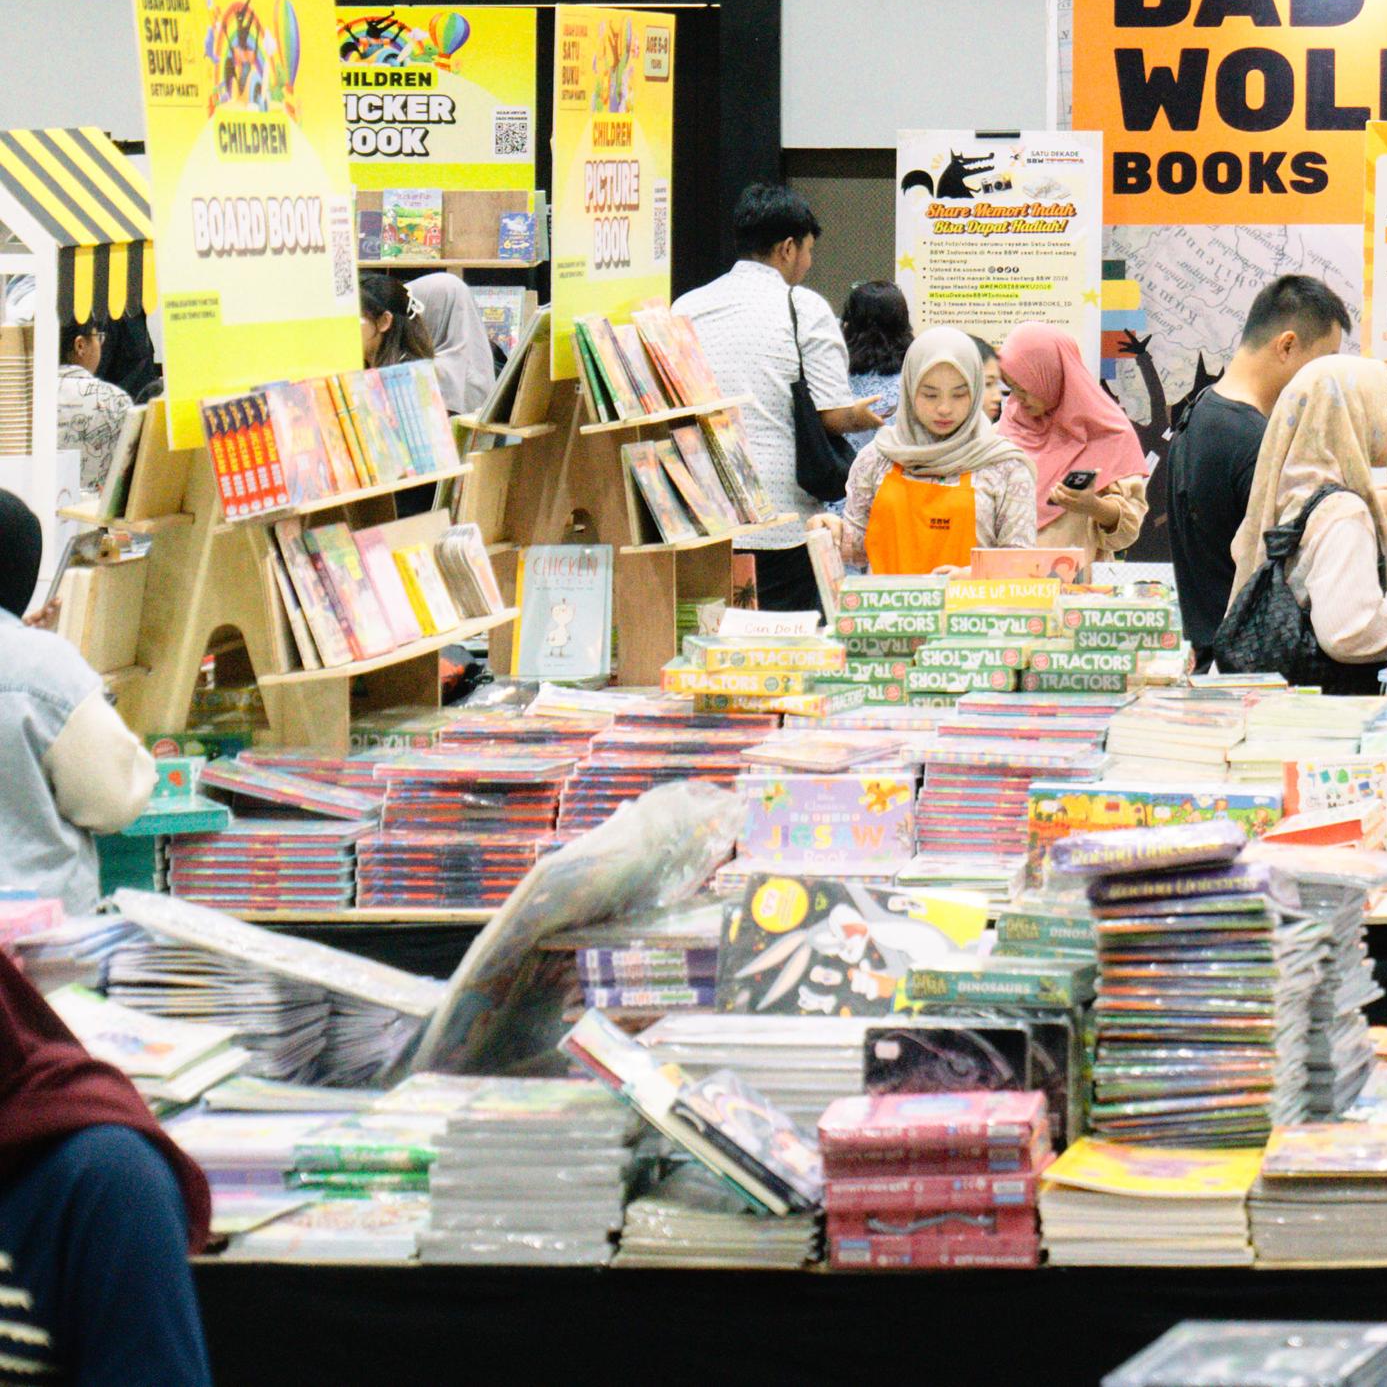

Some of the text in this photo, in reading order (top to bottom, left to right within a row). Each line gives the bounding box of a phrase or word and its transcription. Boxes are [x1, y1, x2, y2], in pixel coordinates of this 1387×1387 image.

[144, 18, 179, 44] SATU
[563, 42, 579, 60] SATU
[148, 50, 182, 75] BUKU
[342, 72, 432, 87] HILDREN
[562, 67, 579, 85] BUKU
[219, 123, 288, 154] CHILDREN
[593, 121, 632, 147] CHILDREN
[1113, 151, 1329, 195] BOOKS
[585, 160, 640, 212] PICTURE
[926, 202, 1077, 218] Share Memori Indah
[192, 196, 325, 258] BOARD BOOK
[933, 220, 964, 234] Bisa
[967, 221, 1010, 236] Dapat
[594, 216, 630, 269] BOOK
[861, 592, 941, 607] TRACTORS
[949, 585, 1005, 599] WAKE UP
[856, 617, 935, 632] TRACTORS
[950, 618, 1027, 632] TRACTORS
[1083, 611, 1165, 627] TRACTORS
[1079, 632, 1160, 647] TRACTORS
[750, 651, 825, 666] TRACTORS
[922, 650, 1002, 666] TRACTORS
[1051, 654, 1131, 670] TRACTORS
[680, 675, 758, 689] TRACTORS
[909, 673, 990, 688] TRACTORS
[1040, 674, 1121, 690] TRACTORS
[764, 825, 884, 849] JIGSAW
[957, 982, 1030, 993] DINOSAURS
